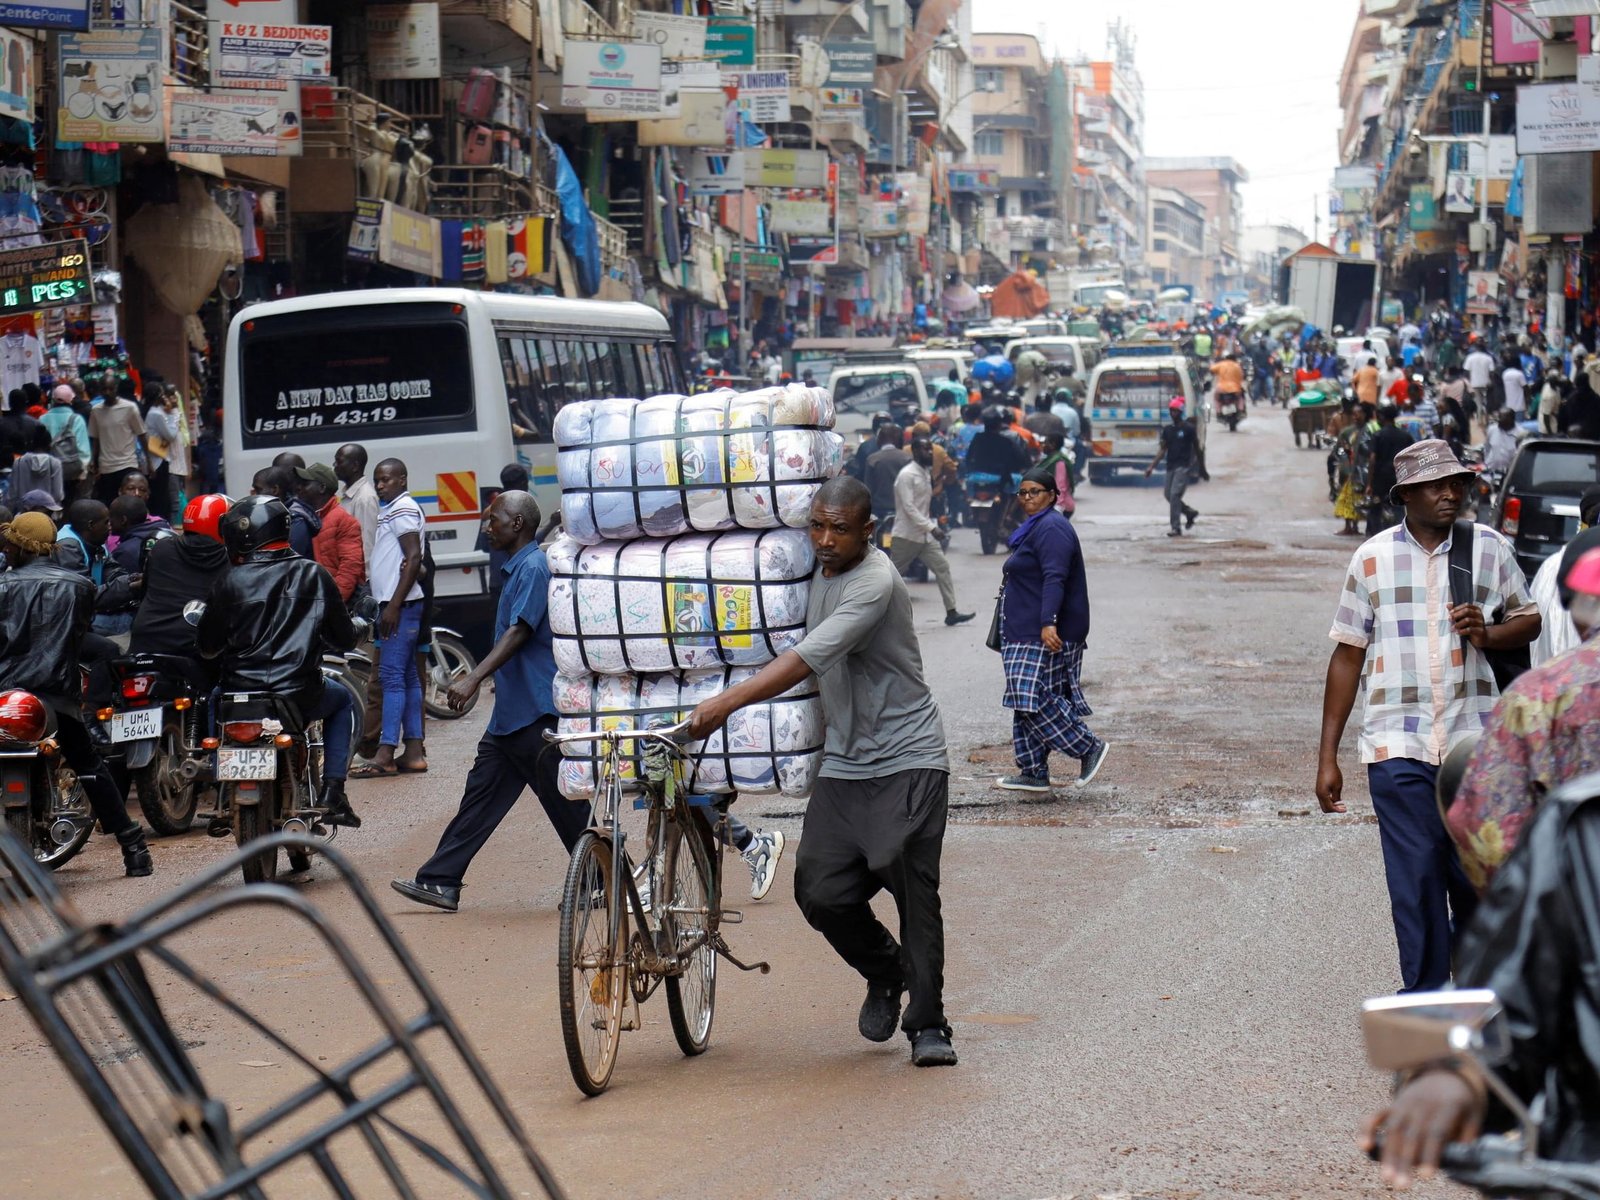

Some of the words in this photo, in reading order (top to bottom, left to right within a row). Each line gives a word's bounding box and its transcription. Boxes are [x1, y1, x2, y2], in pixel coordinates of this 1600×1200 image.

[0, 6, 72, 23] CentePoint
[224, 24, 233, 36] K
[236, 24, 247, 36] &
[249, 25, 258, 37] Z
[263, 26, 329, 40] BEDDINGS
[247, 40, 297, 48] INTERIORS
[747, 72, 787, 88] UNIFORMS
[276, 391, 288, 409] A
[289, 388, 322, 408] NEW
[325, 386, 355, 405] DAY
[356, 383, 388, 403] HAS
[390, 379, 431, 399] COME
[254, 412, 323, 432] Isaiah
[333, 407, 397, 425] 43:19
[130, 712, 150, 724] UMA
[123, 725, 156, 738] 564KV
[239, 750, 267, 764] UFX
